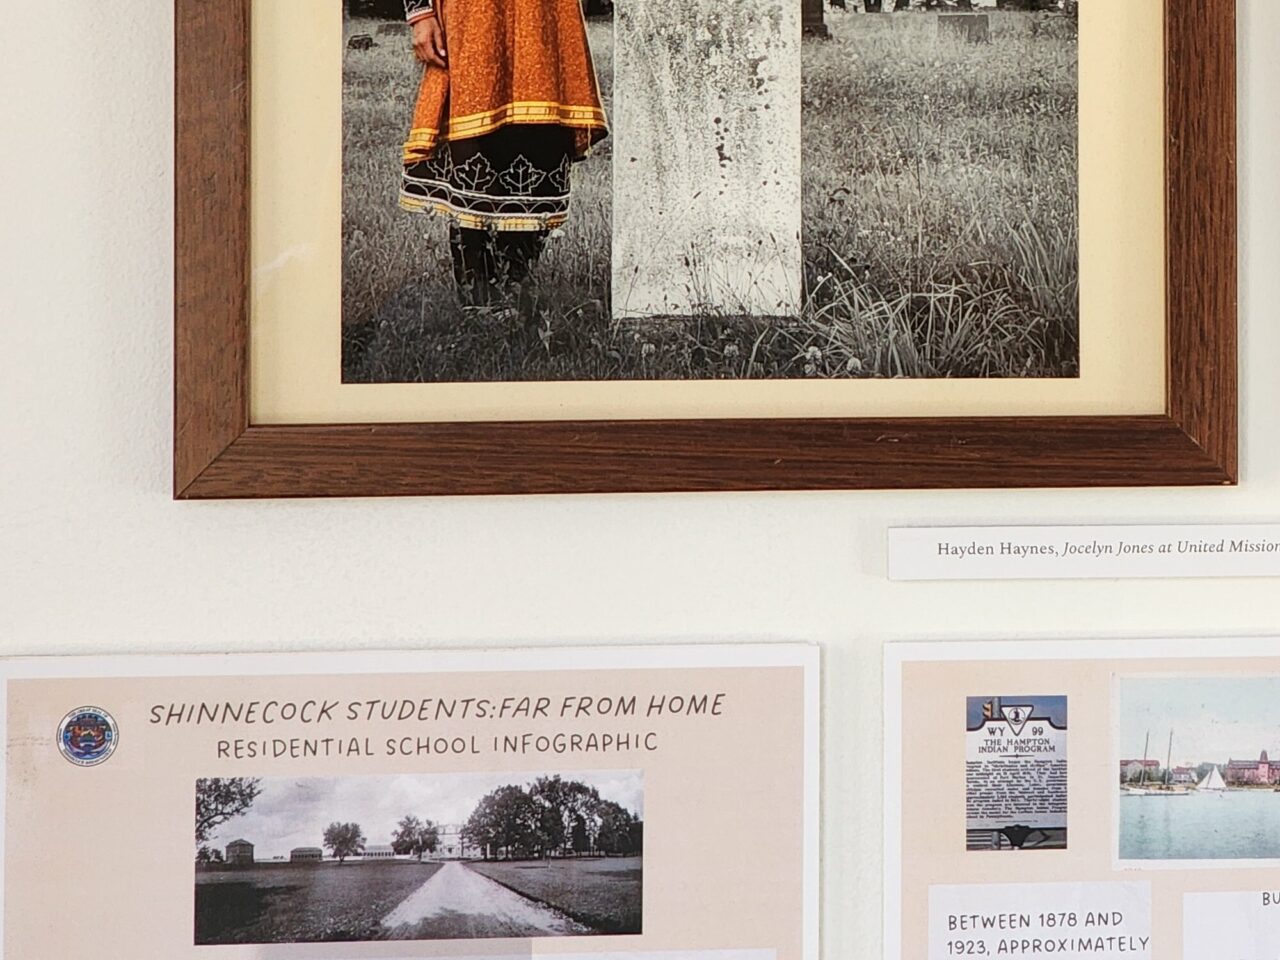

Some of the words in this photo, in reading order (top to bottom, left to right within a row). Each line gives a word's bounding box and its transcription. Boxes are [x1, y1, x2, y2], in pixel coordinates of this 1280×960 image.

[937, 541, 994, 559] Hayden
[1000, 542, 1060, 560] Haynes,
[1061, 540, 1113, 558] Jocelyn
[1115, 541, 1154, 557] Jones
[1159, 544, 1171, 553] at
[1177, 539, 1225, 554] United
[149, 700, 340, 726] SHINNECOCK
[559, 695, 637, 718] FROM
[646, 693, 726, 718] HOME
[988, 727, 1004, 736] WY
[1032, 727, 1043, 736] 99
[217, 737, 375, 760] RESIDENTIAL
[386, 735, 480, 756] SCHOOL
[494, 732, 658, 754] INFOGRAPHIC
[978, 745, 1009, 753] INDIAN
[1013, 745, 1056, 753] PROGRAM
[1006, 738, 1050, 746] HAMPTON
[948, 913, 1031, 931] BETWEEN
[1038, 912, 1078, 928] 1878
[1084, 911, 1123, 927] AND
[947, 939, 991, 957] 1923,
[997, 936, 1150, 955] APPROXIMATELY
